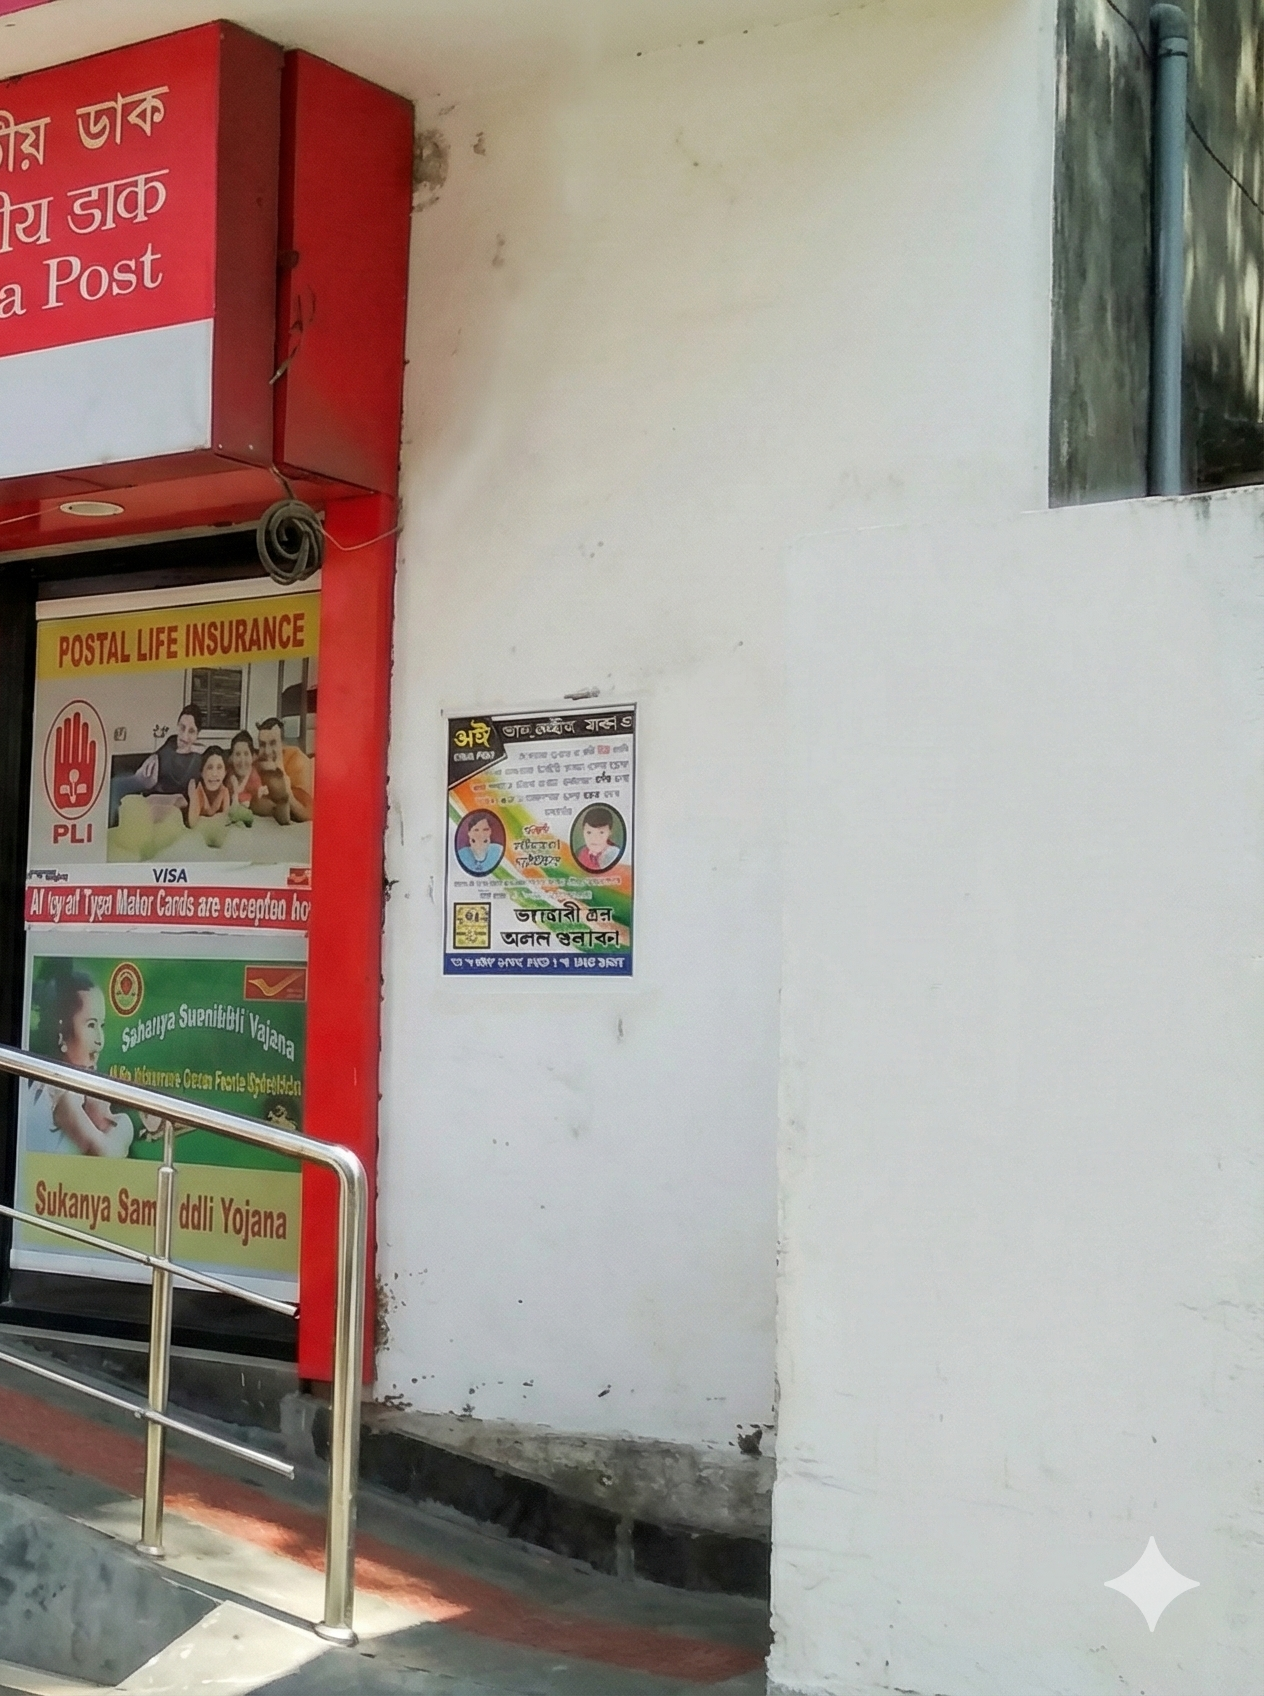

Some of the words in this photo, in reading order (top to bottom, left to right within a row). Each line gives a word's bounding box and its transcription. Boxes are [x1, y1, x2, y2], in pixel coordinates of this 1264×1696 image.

[76, 86, 169, 151] ডাক
[66, 169, 169, 233] डाक
[41, 242, 164, 310] Post
[58, 630, 131, 668] POSTAL
[137, 625, 179, 662] LIFE
[185, 613, 306, 658] INSURANCE
[53, 823, 93, 845] PLI
[152, 868, 188, 883] VISA
[36, 1180, 111, 1230] Sukanya
[221, 1197, 287, 1247] Yojana
